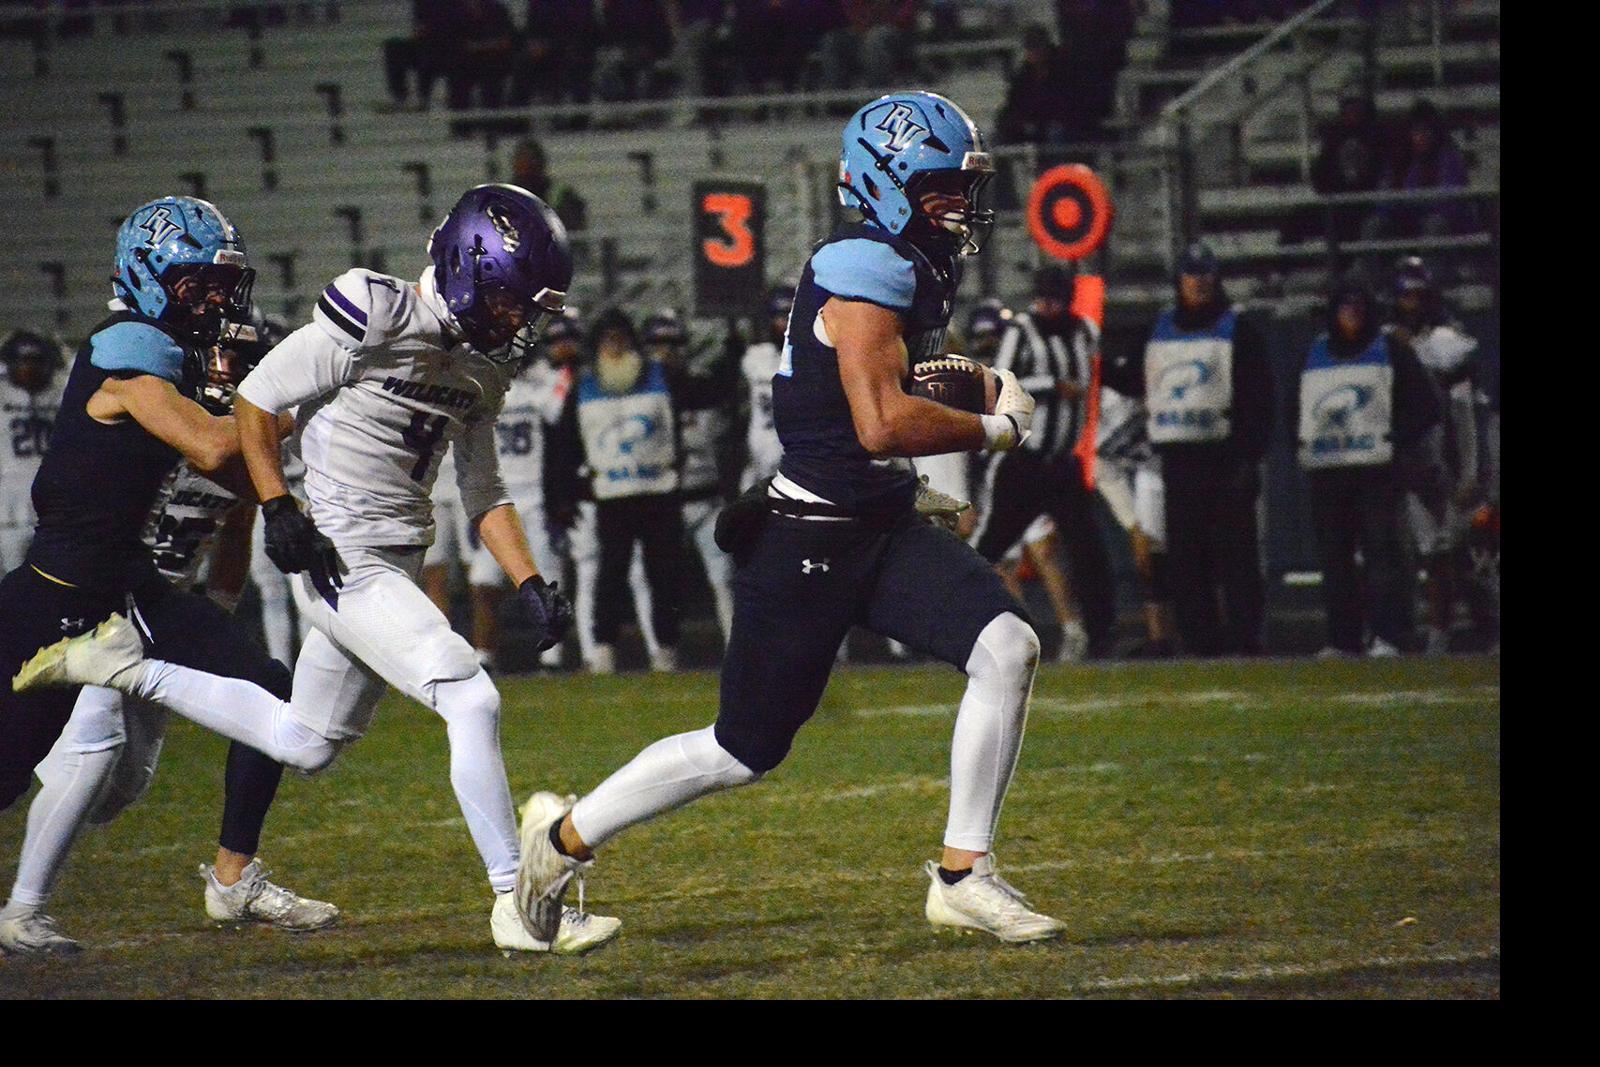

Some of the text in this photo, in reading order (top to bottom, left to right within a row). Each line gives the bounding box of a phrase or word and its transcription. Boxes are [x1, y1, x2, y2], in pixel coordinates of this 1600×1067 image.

[873, 102, 928, 153] RV
[703, 193, 753, 268] 3
[401, 410, 450, 481] 4
